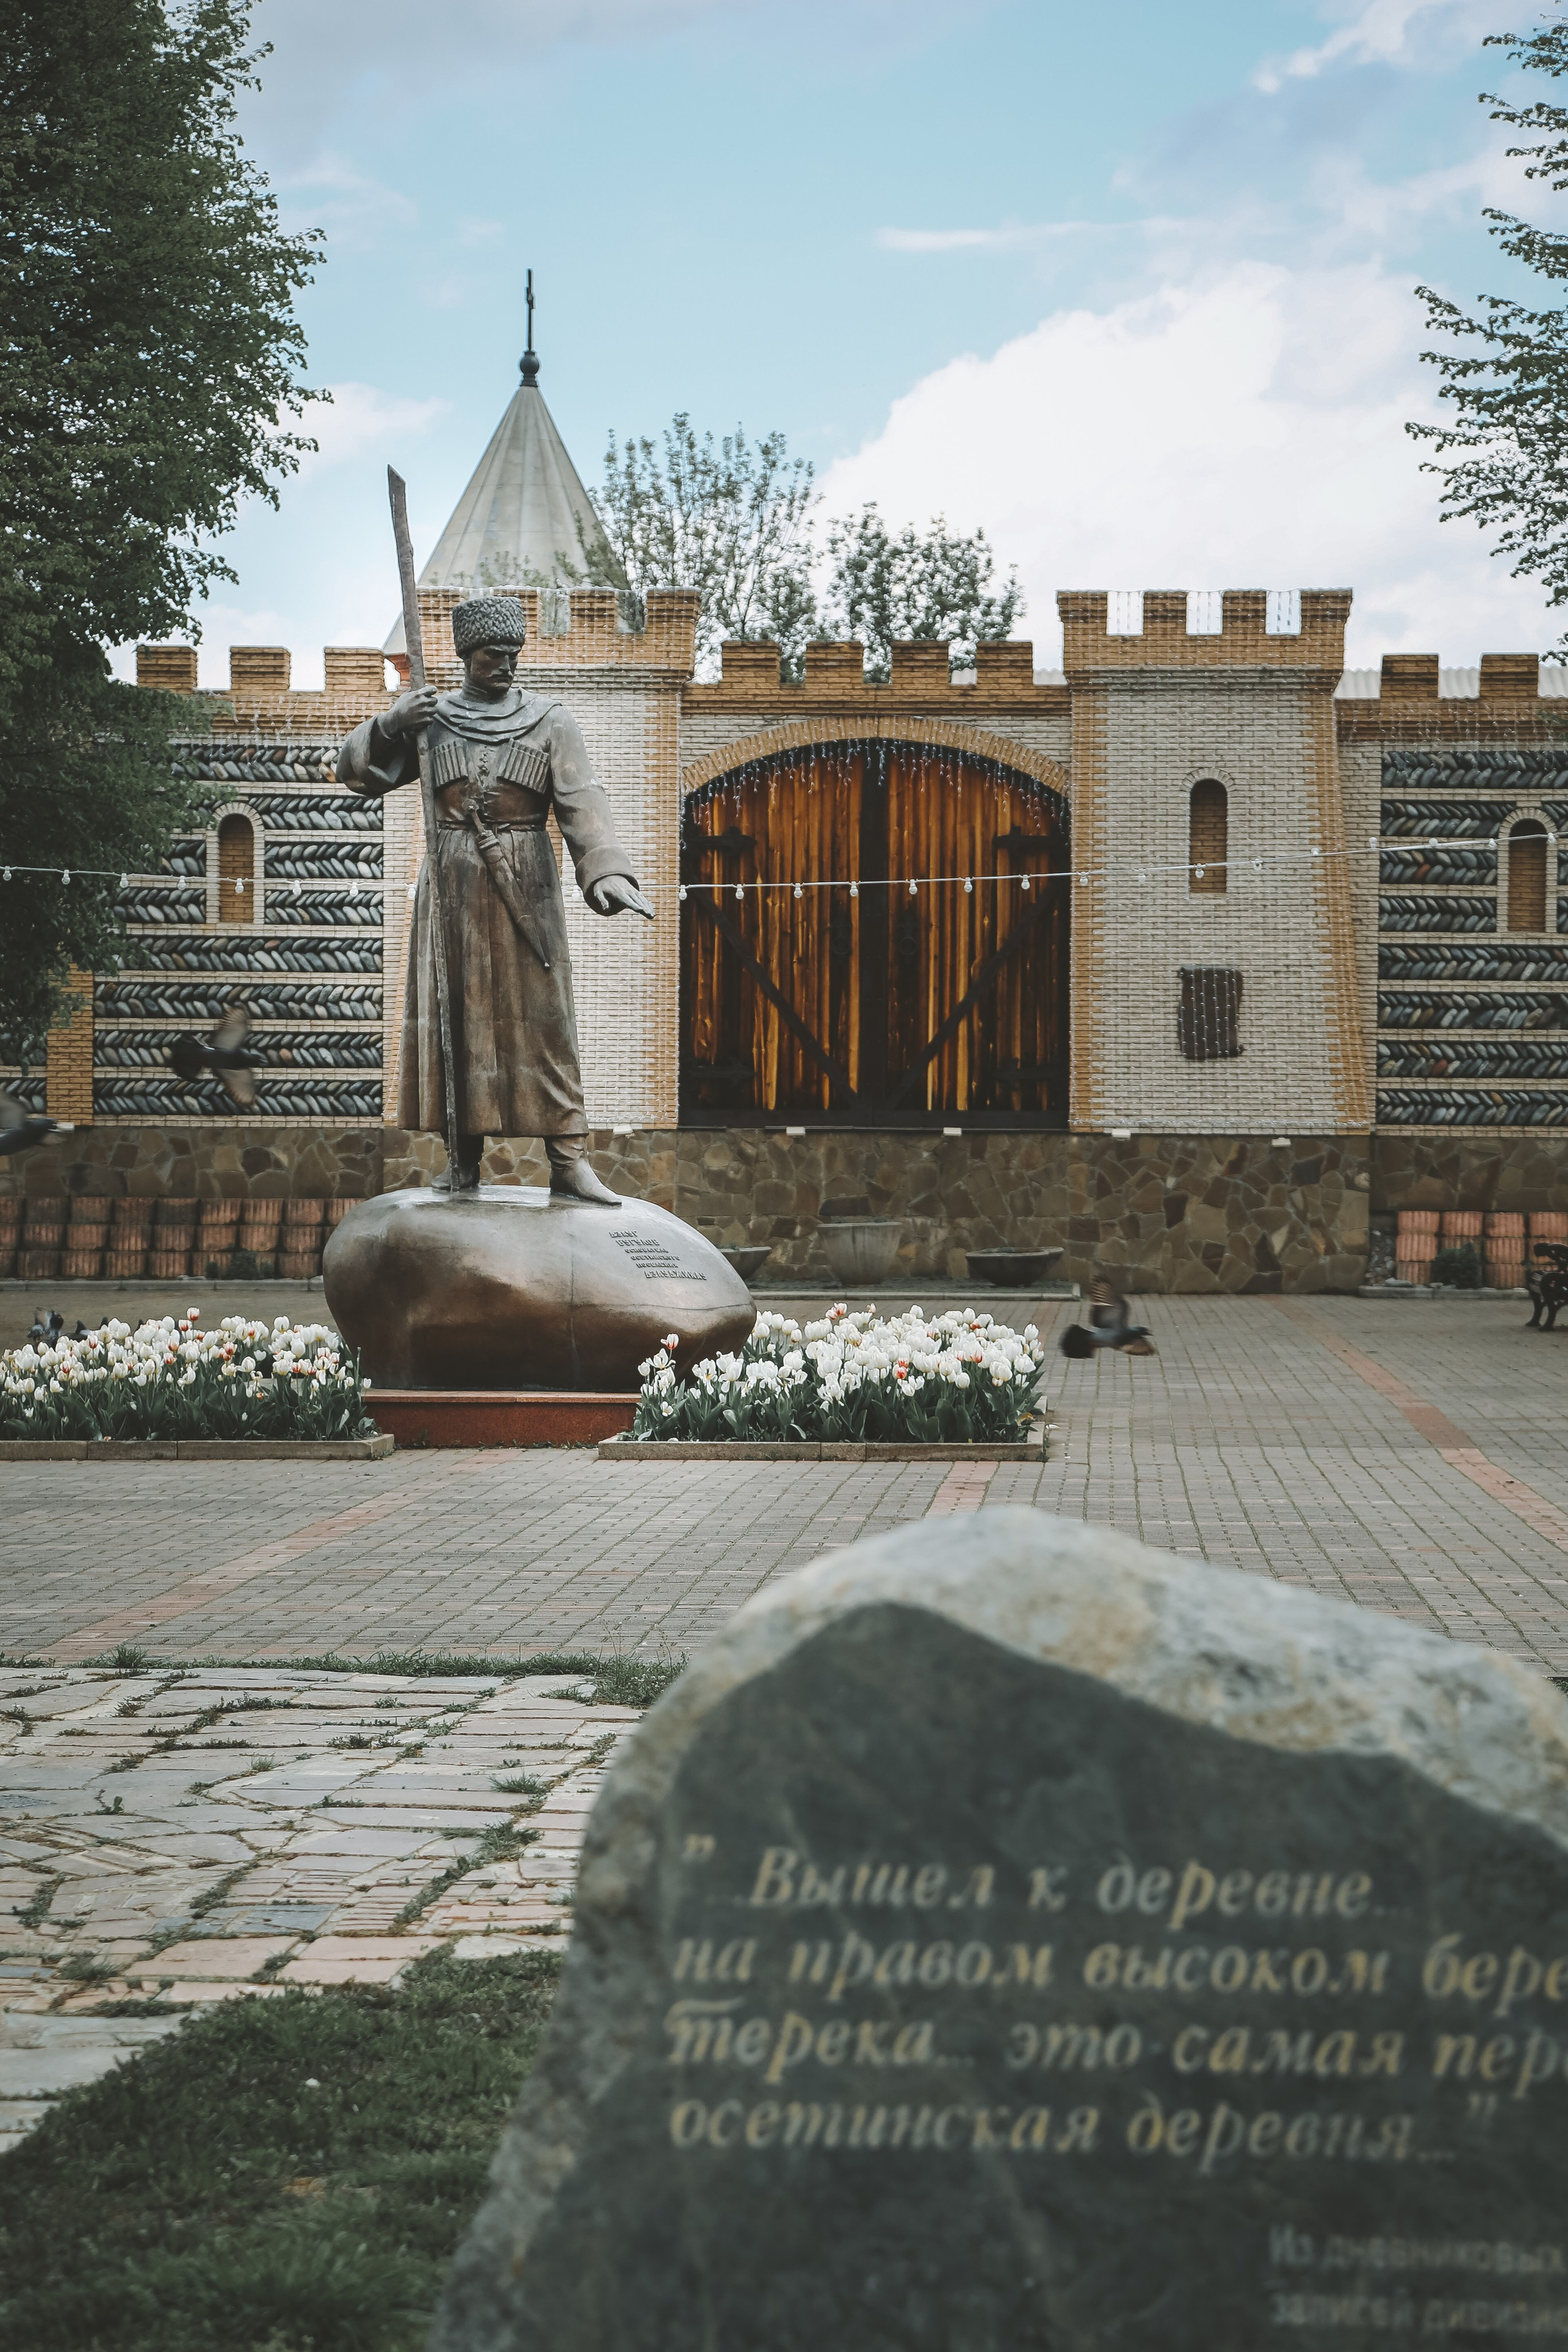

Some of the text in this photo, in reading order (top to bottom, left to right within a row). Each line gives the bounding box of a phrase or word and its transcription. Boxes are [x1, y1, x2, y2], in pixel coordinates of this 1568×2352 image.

[1027, 1866, 1069, 1911] к
[672, 1937, 758, 1984] на
[789, 1929, 1054, 2003] правом
[1082, 1942, 1392, 1996] высоком
[1005, 2021, 1142, 2071] это
[1171, 2023, 1406, 2078] самая
[1431, 2024, 1568, 2100] пер
[668, 2097, 1100, 2154] осетинская
